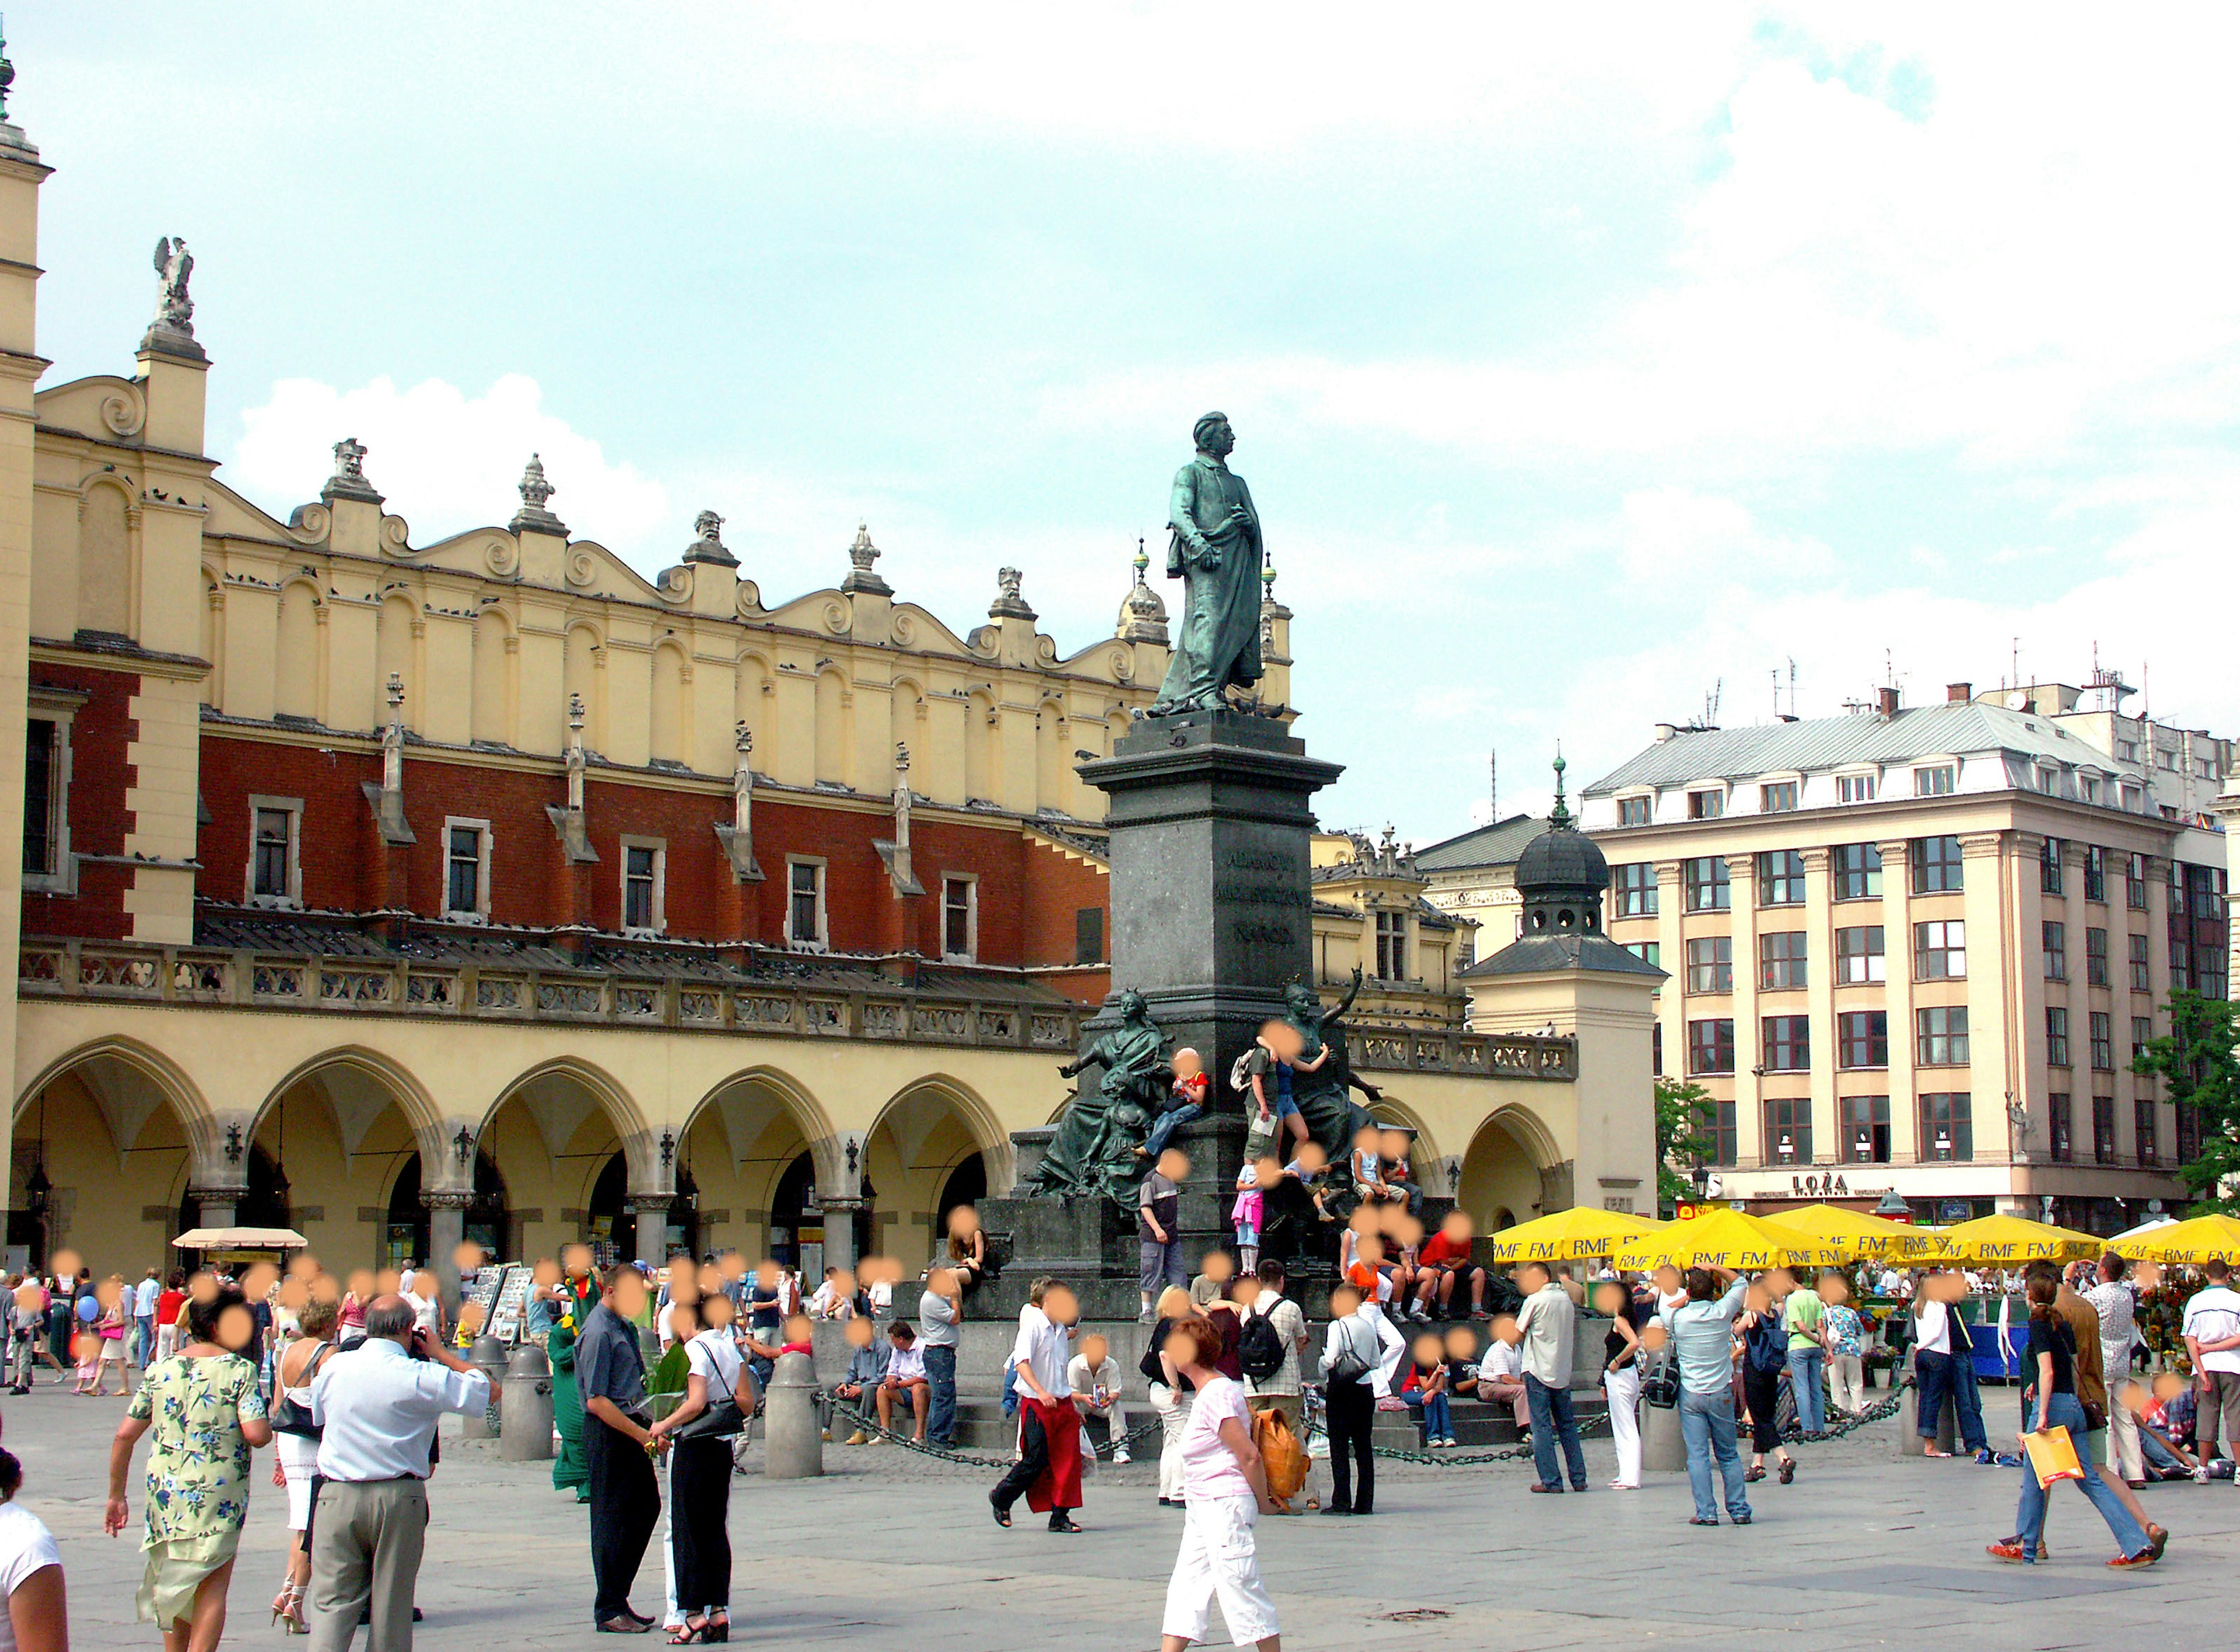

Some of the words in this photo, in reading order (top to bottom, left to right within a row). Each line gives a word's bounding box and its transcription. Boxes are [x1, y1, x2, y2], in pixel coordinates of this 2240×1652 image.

[1529, 1242, 1554, 1257] FM
[1573, 1237, 1612, 1255] RMF
[1859, 1236, 1887, 1251] FM
[1904, 1236, 1928, 1252] RMF
[1980, 1243, 2018, 1257] RMF
[2027, 1242, 2054, 1256] FM
[2127, 1245, 2147, 1257] FM
[1619, 1254, 1651, 1268] RMF
[1653, 1254, 1674, 1268] FM
[1693, 1252, 1731, 1265] RMF
[1741, 1252, 1768, 1265] FM
[1787, 1250, 1811, 1264] RMF
[1819, 1250, 1839, 1262] FM
[2164, 1248, 2199, 1261] RMF
[2207, 1250, 2233, 1263] FM
